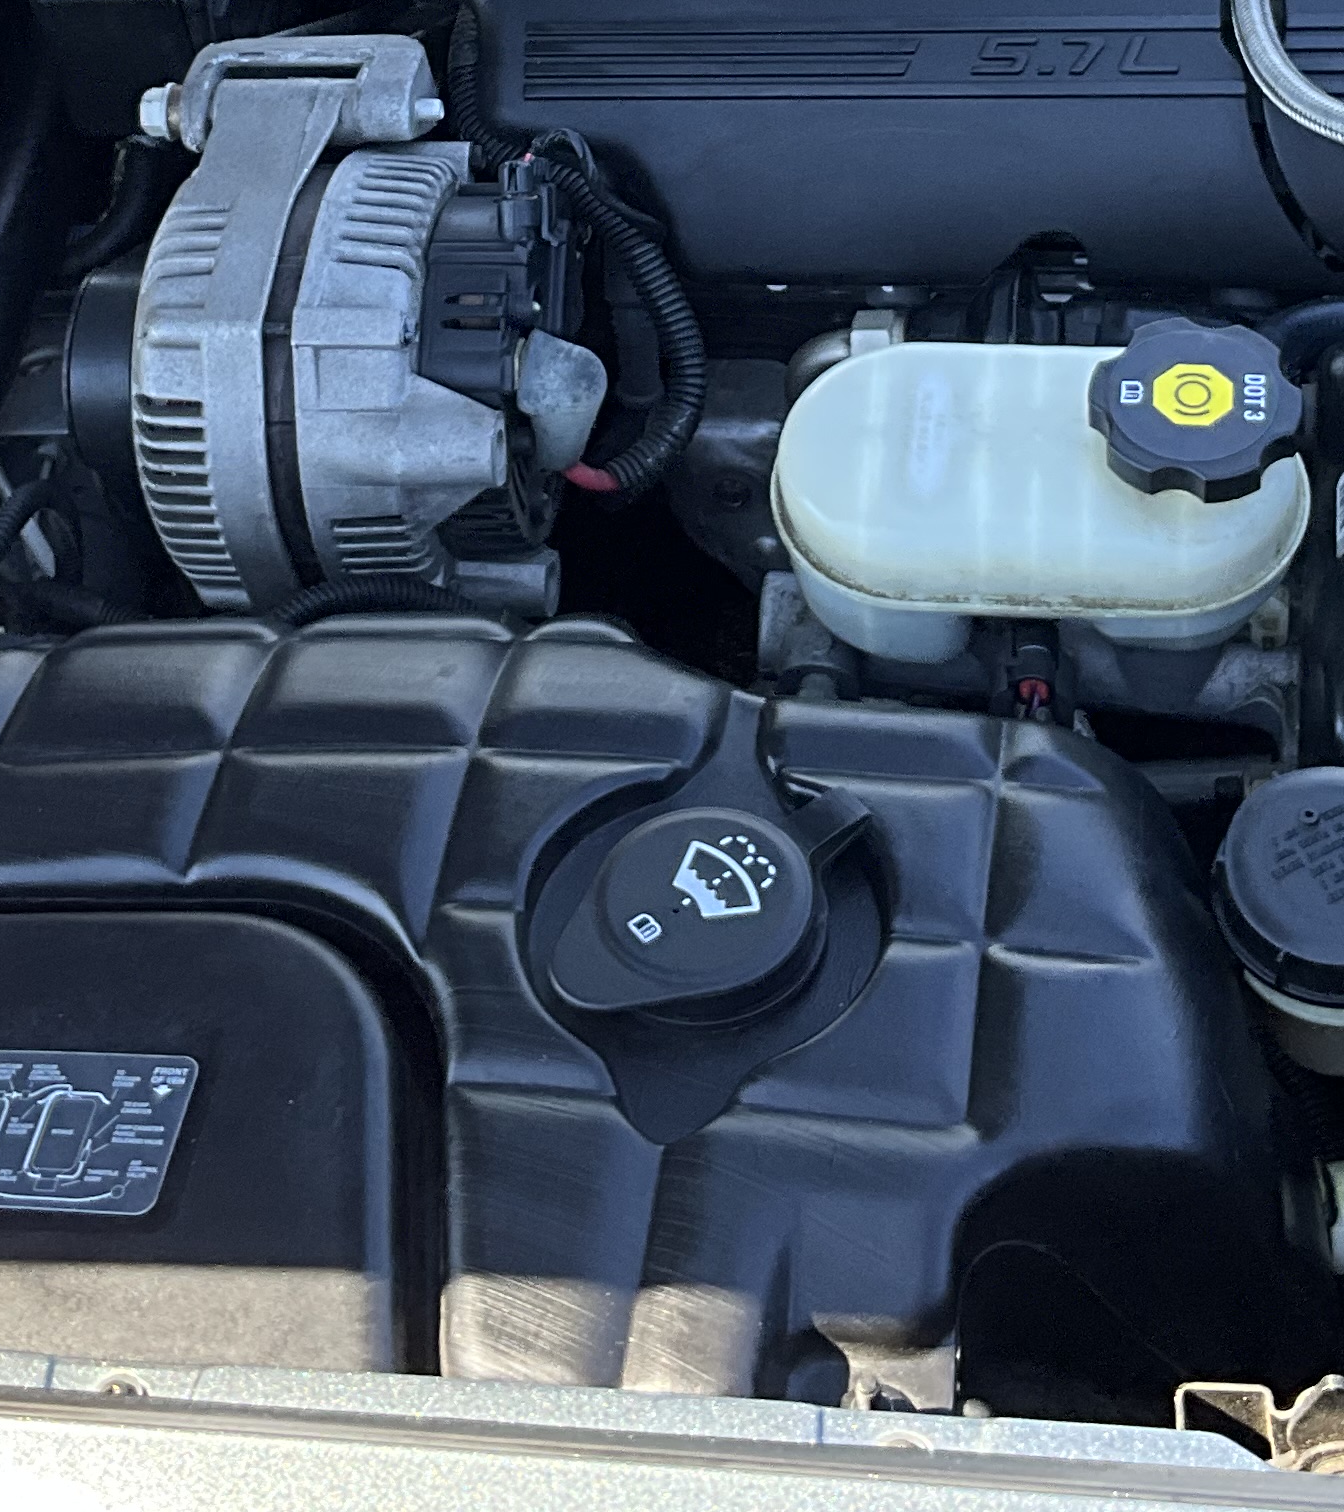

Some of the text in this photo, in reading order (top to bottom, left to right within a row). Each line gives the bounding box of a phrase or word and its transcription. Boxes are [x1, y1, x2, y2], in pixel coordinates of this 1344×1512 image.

[968, 32, 1188, 80] 5.7L
[1242, 372, 1269, 424] DOT 3
